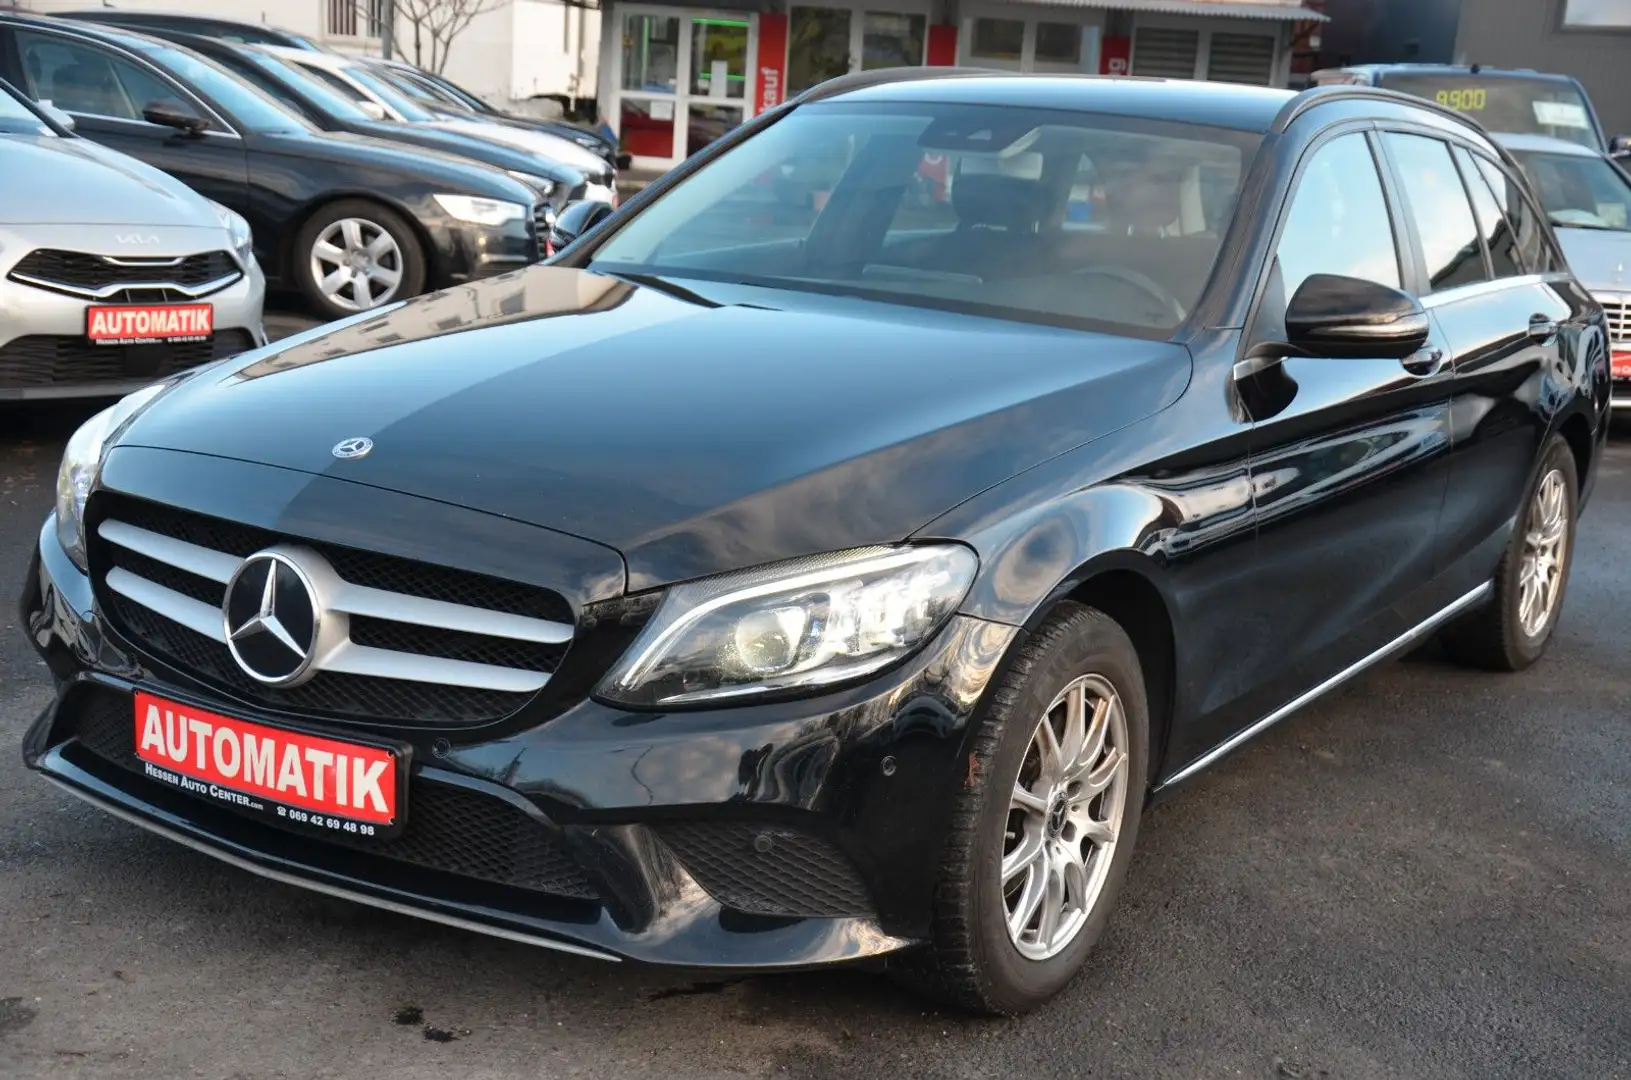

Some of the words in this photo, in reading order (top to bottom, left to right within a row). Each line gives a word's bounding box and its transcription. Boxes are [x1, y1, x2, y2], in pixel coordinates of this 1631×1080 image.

[91, 309, 210, 335] AUTOMATIK
[141, 703, 389, 813] AUTOMATIK
[145, 762, 179, 786] HESSEN
[181, 775, 207, 794] AUTO
[289, 809, 308, 822] 069
[310, 815, 324, 826] 42
[326, 818, 340, 830] 69
[343, 821, 357, 833] 48
[360, 825, 375, 836] 98
